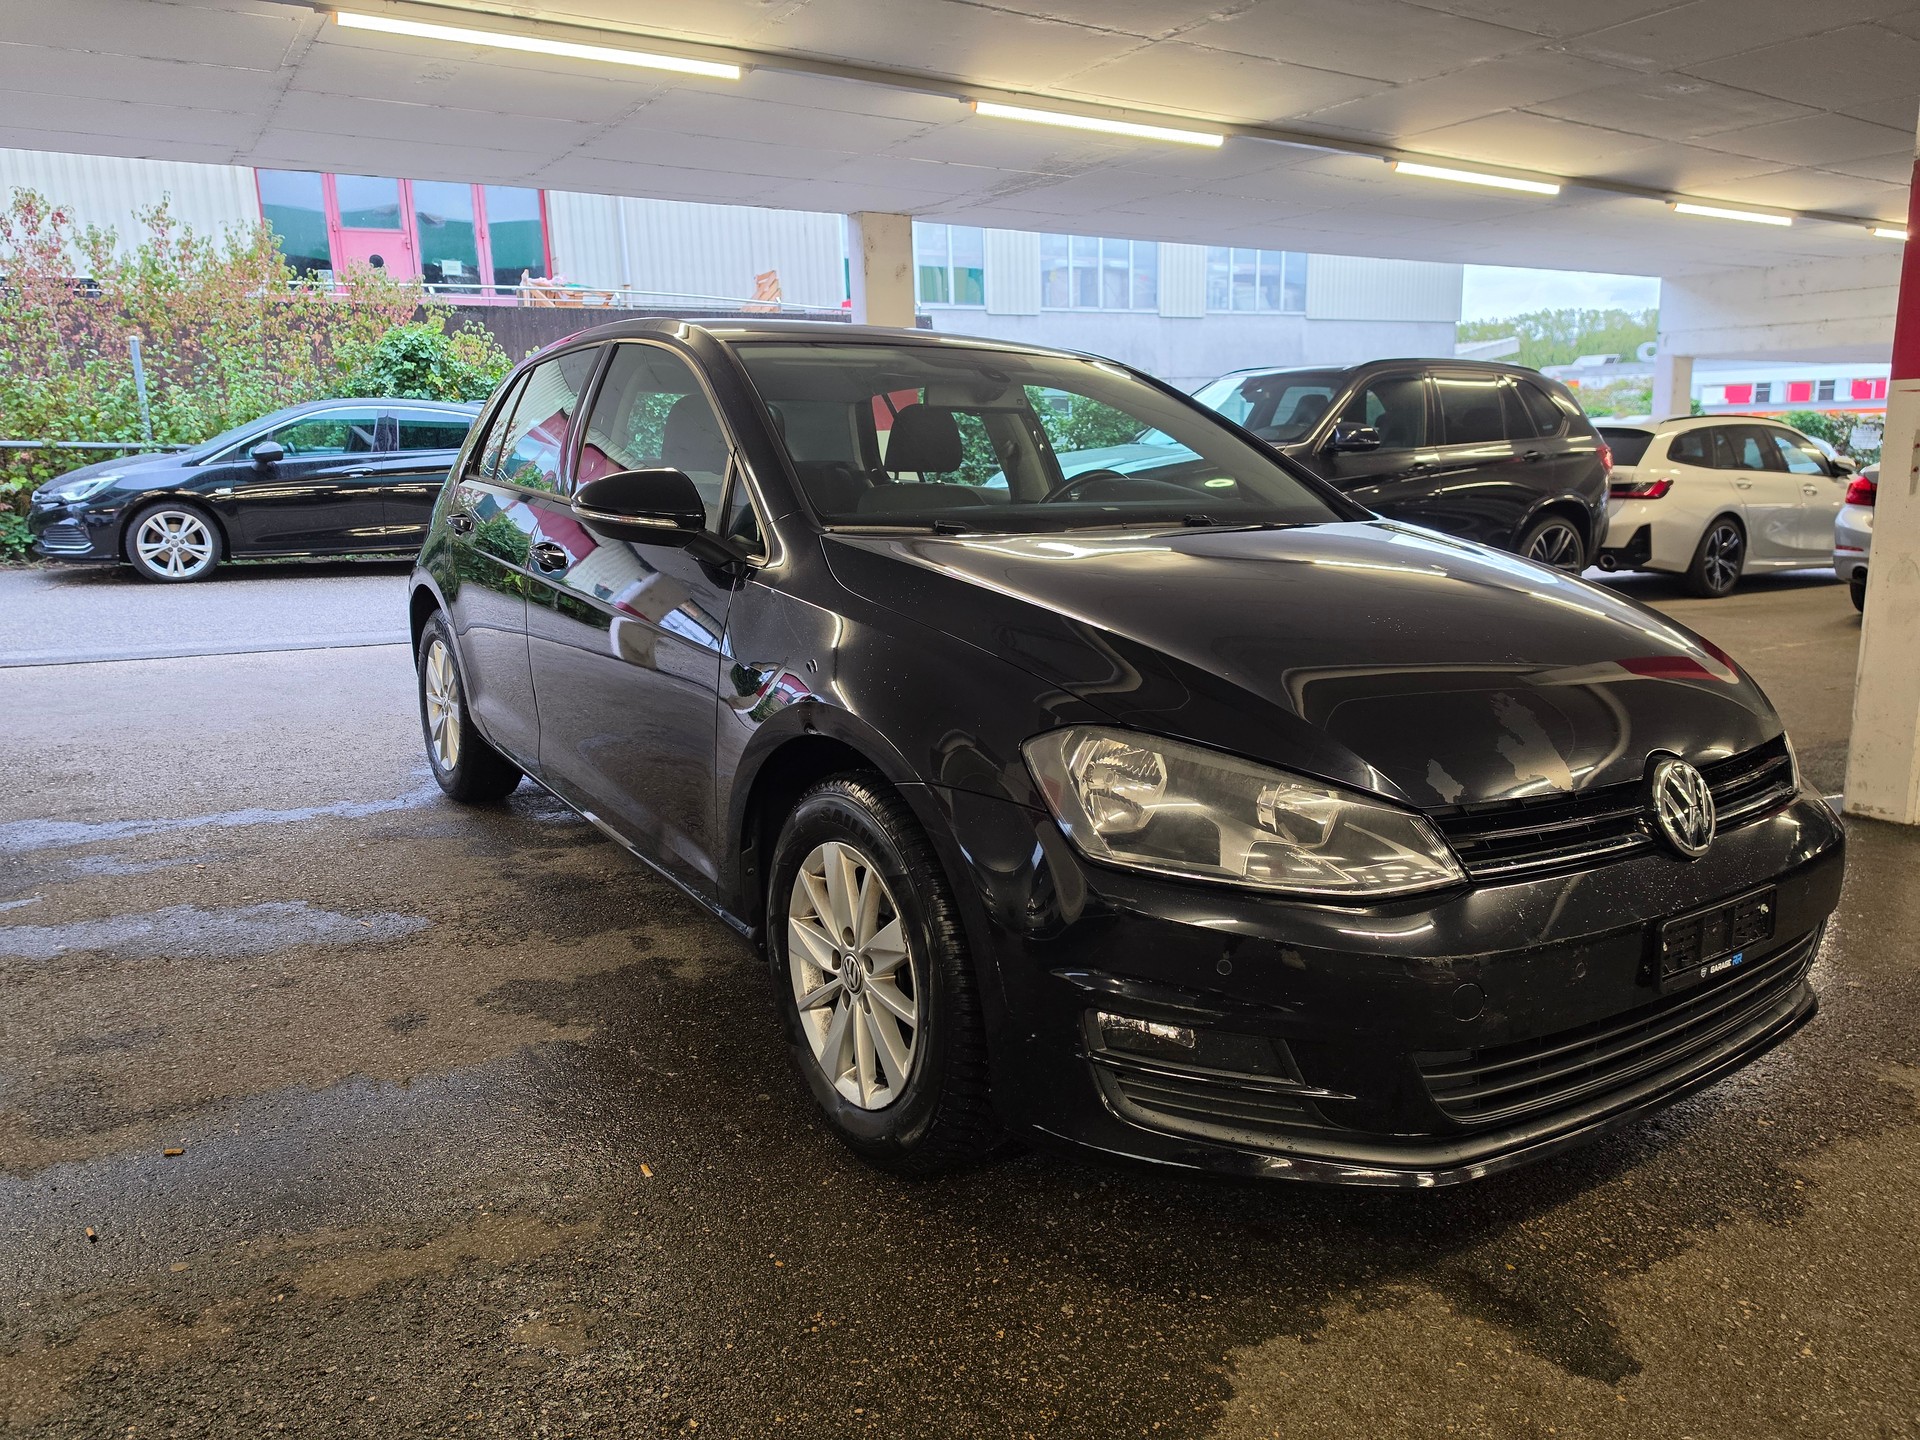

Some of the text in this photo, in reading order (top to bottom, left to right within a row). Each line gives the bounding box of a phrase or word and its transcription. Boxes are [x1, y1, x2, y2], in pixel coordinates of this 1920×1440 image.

[1655, 760, 1714, 855] VW
[820, 806, 889, 868] SAILUN
[843, 955, 861, 991] VW
[1710, 959, 1732, 973] GARAGE
